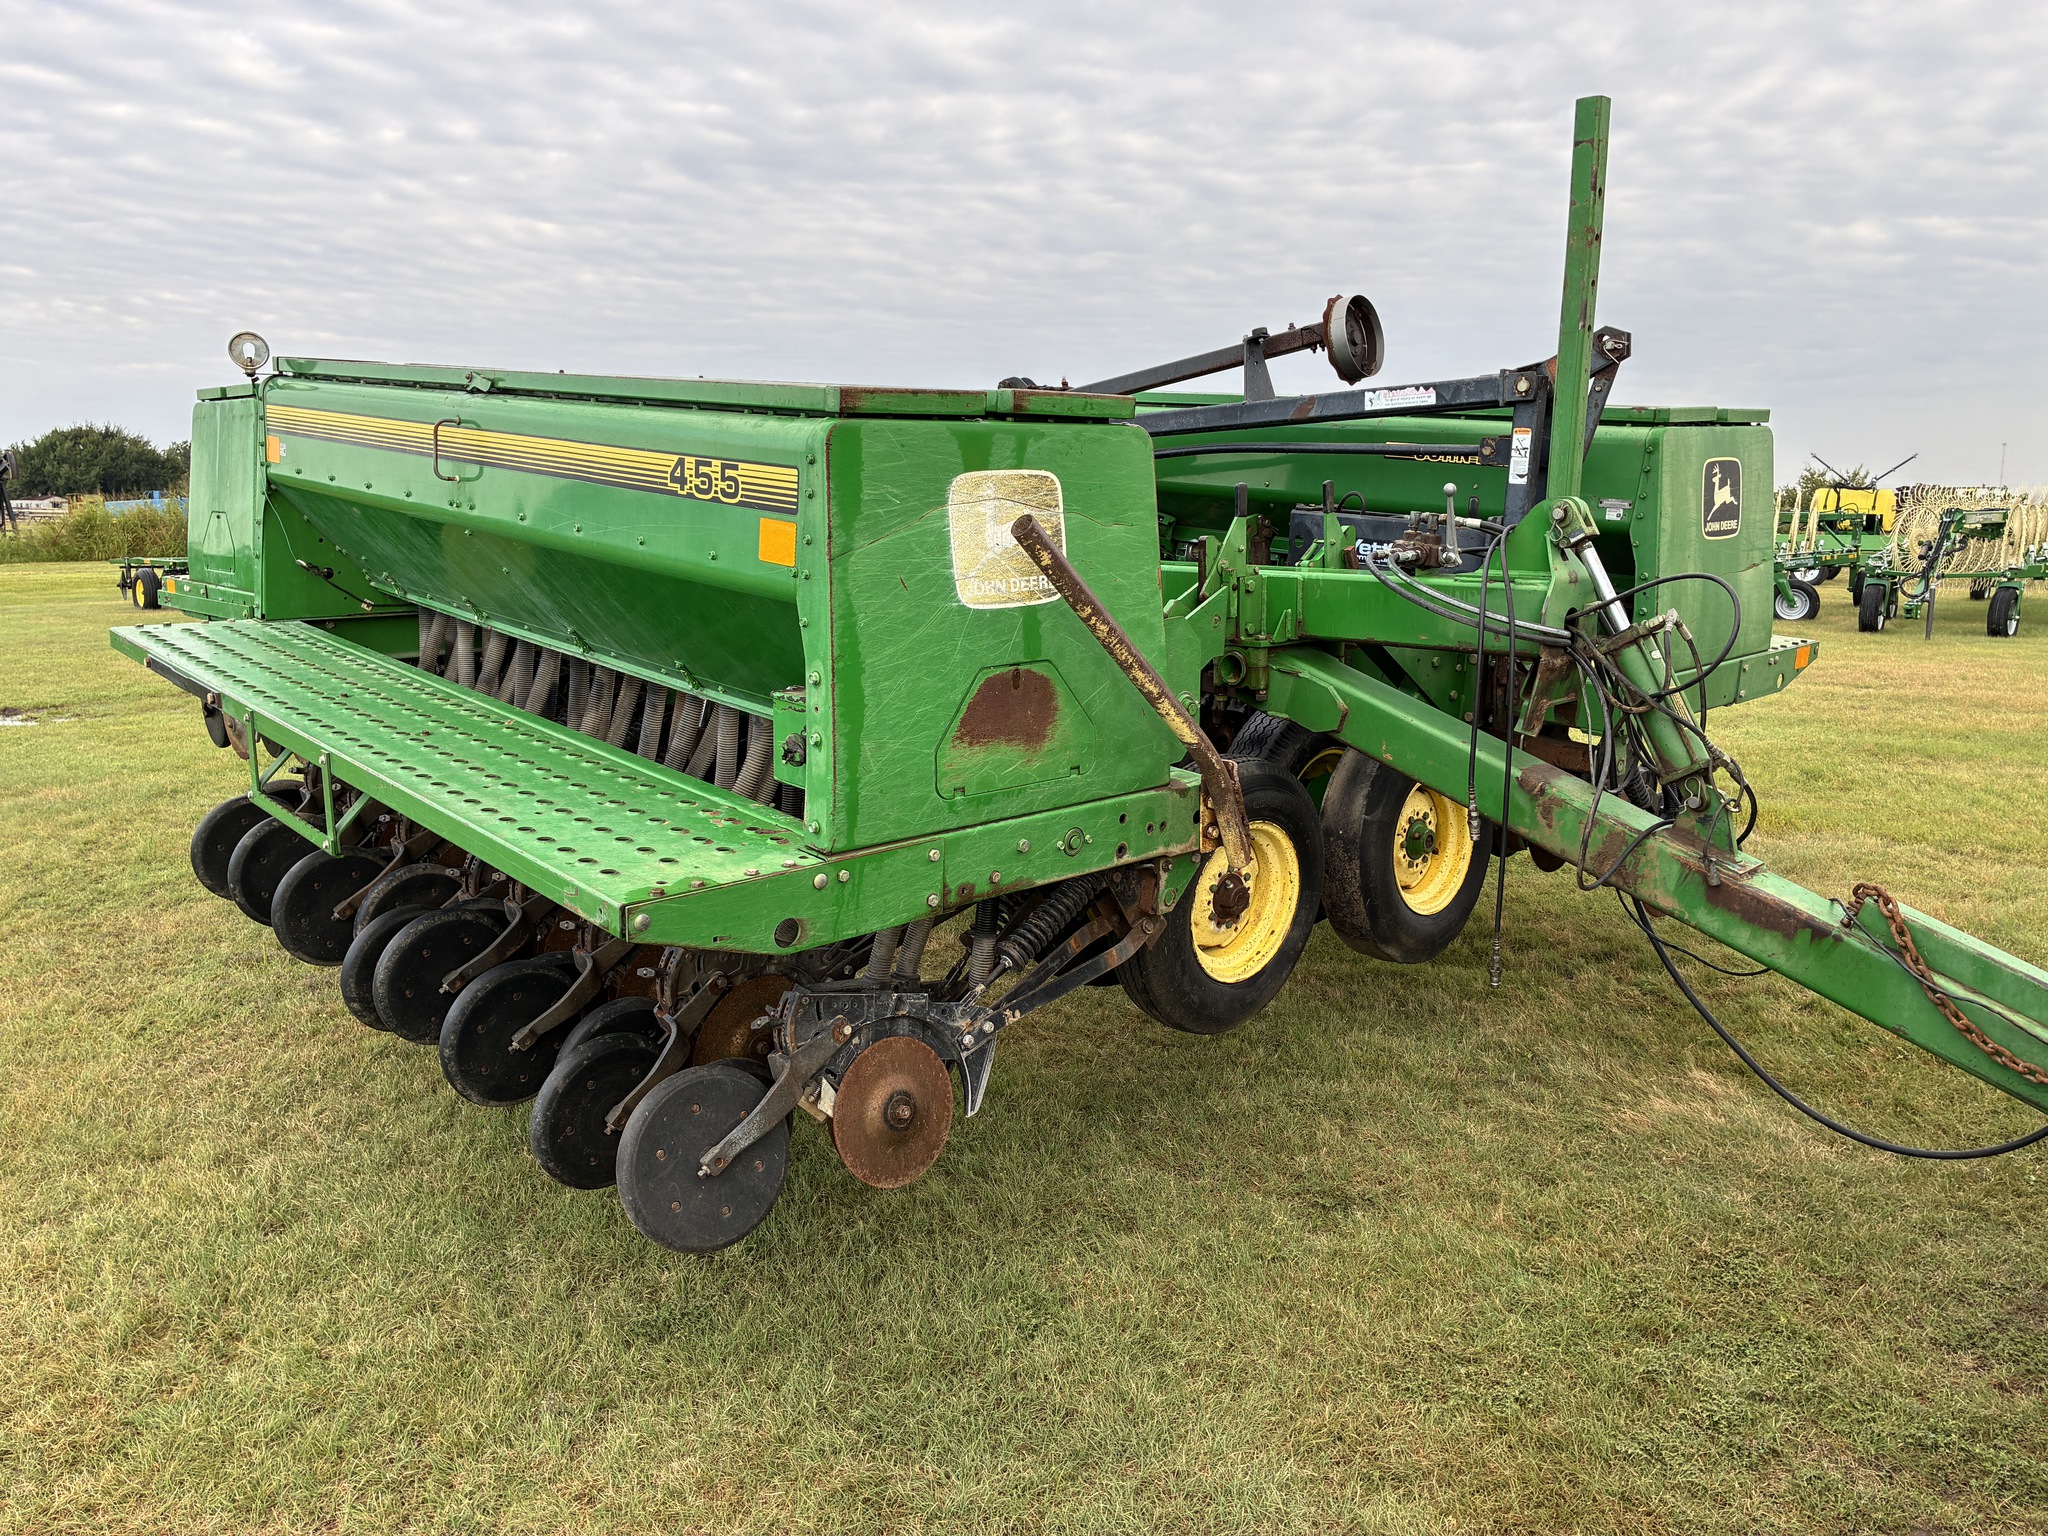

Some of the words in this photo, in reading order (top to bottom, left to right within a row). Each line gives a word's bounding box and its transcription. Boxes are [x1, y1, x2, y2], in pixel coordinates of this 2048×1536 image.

[668, 456, 742, 504] 455
[1705, 521, 1720, 532] JOHN
[1721, 520, 1738, 530] DEERE
[1010, 575, 1057, 593] DEER
